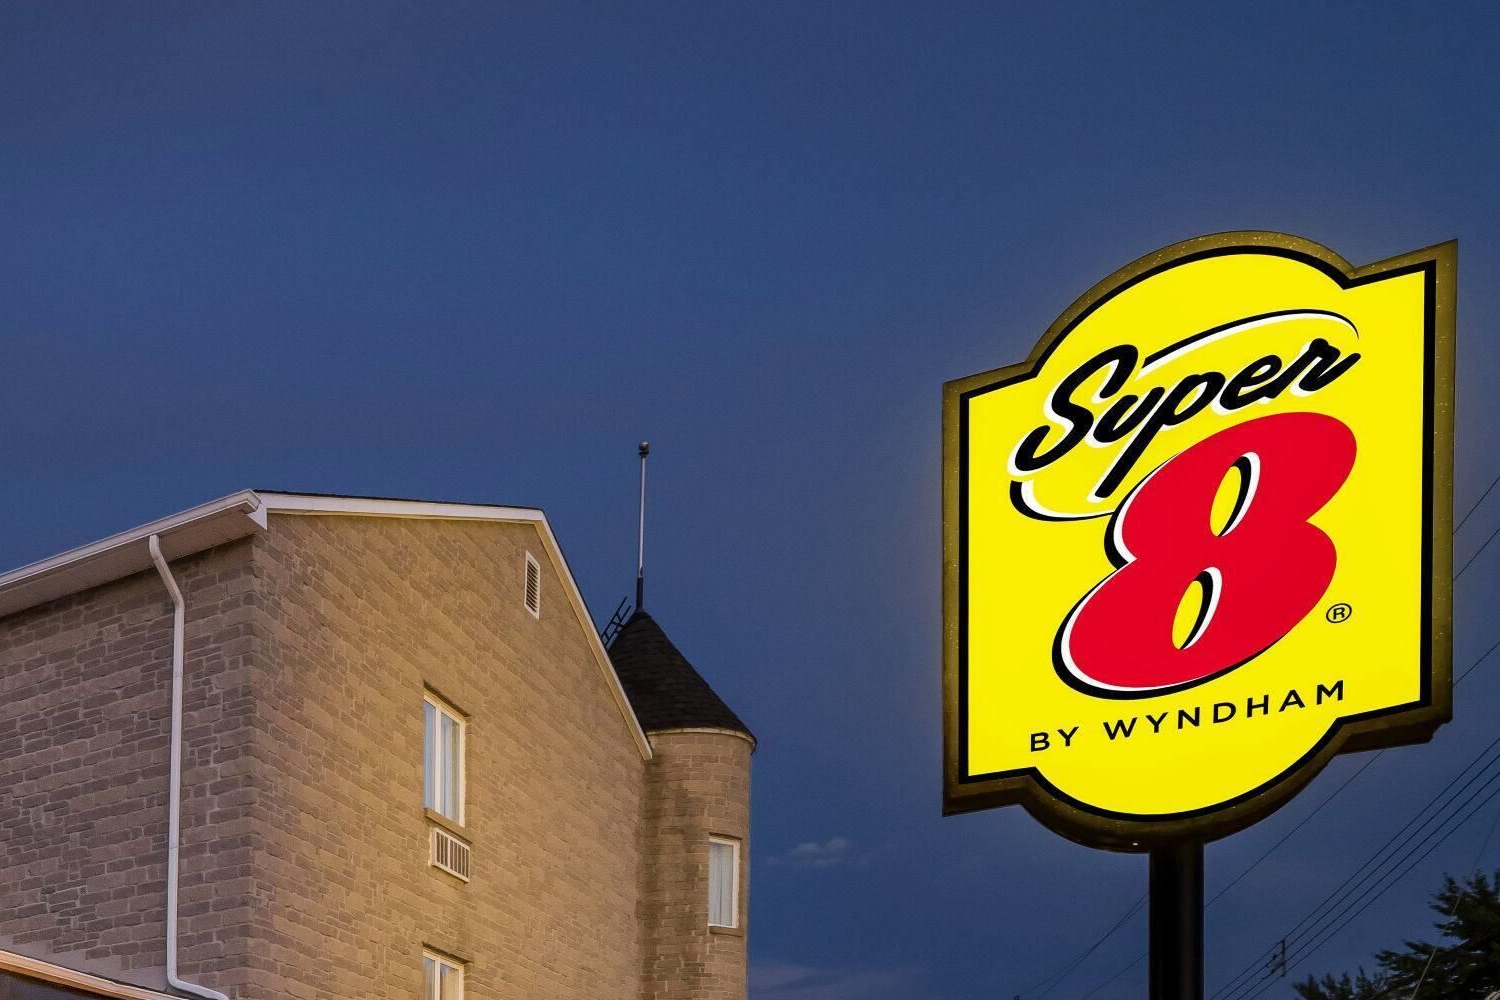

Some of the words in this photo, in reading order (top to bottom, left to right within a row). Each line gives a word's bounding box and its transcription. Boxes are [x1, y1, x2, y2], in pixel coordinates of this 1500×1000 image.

[1010, 337, 1361, 500] Super
[1052, 411, 1357, 700] 8
[1030, 726, 1080, 753] BY
[1102, 679, 1344, 741] WYNDHAM
